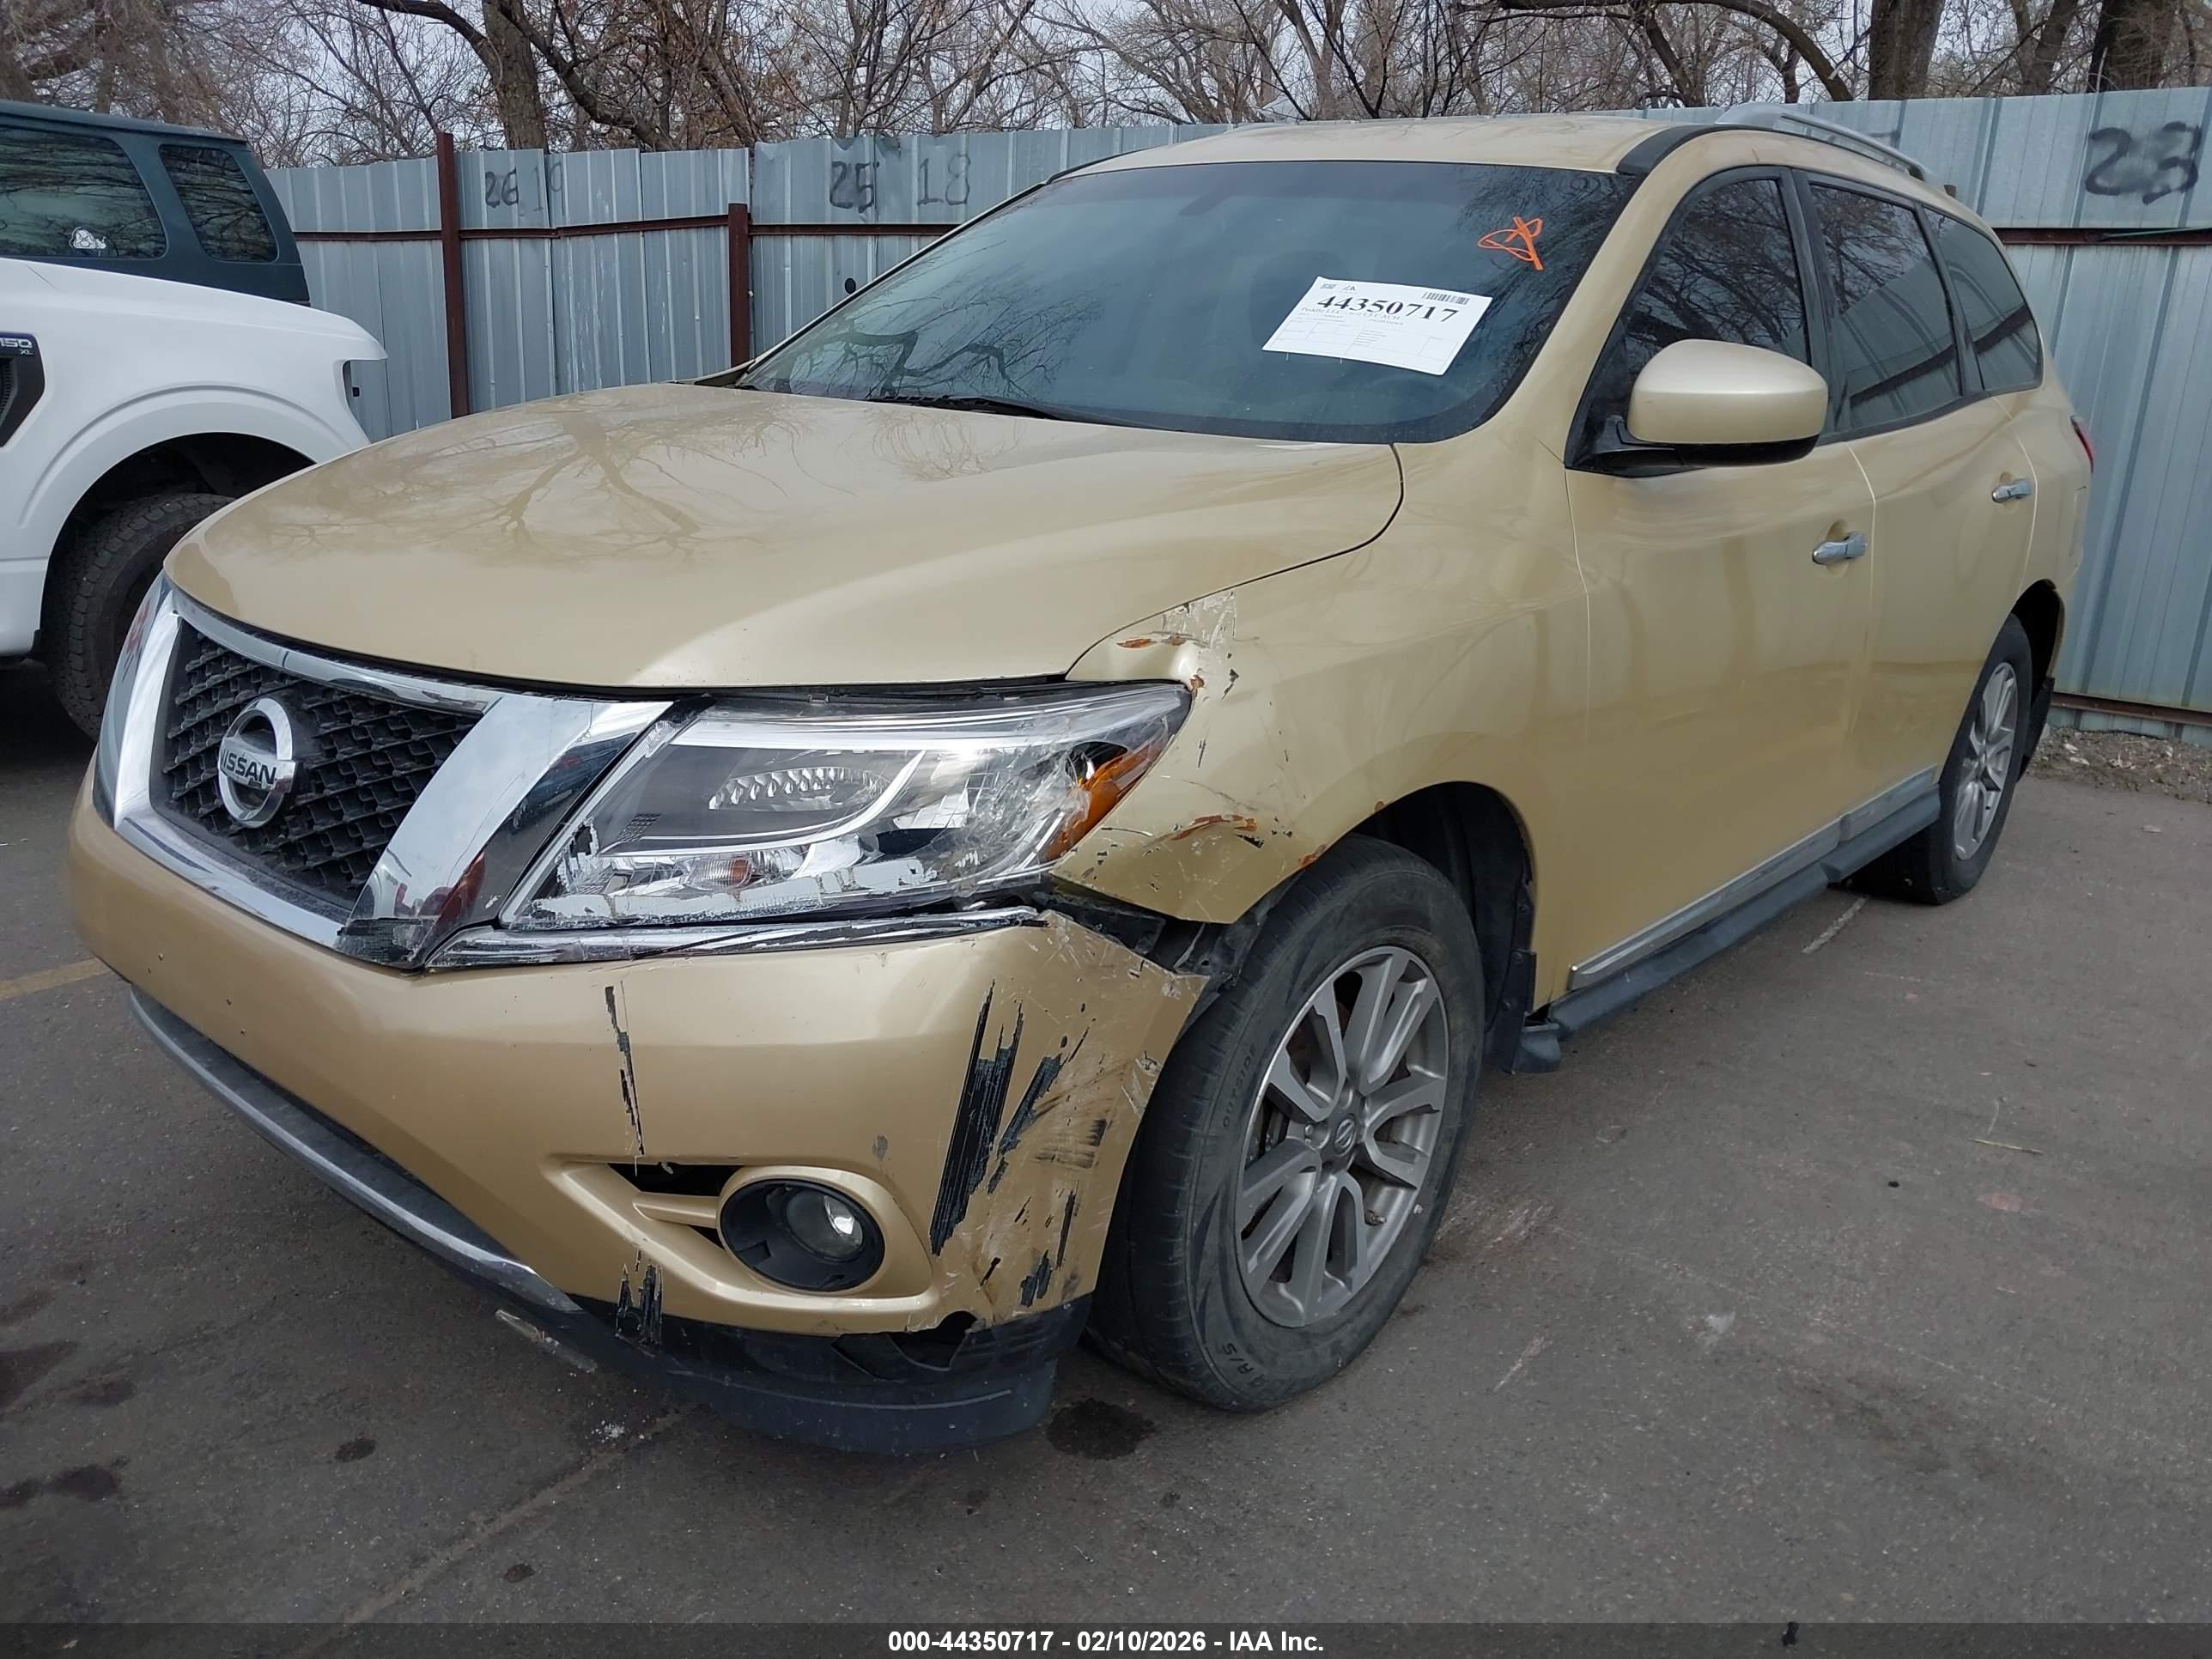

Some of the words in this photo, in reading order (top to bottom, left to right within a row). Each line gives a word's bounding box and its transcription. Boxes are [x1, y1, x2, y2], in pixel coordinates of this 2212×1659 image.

[830, 160, 880, 214] 25
[917, 152, 972, 206] 18
[2086, 121, 2202, 205] 23
[484, 167, 520, 208] 26
[1316, 295, 1460, 323] 44350717
[219, 749, 277, 785] NISSAN
